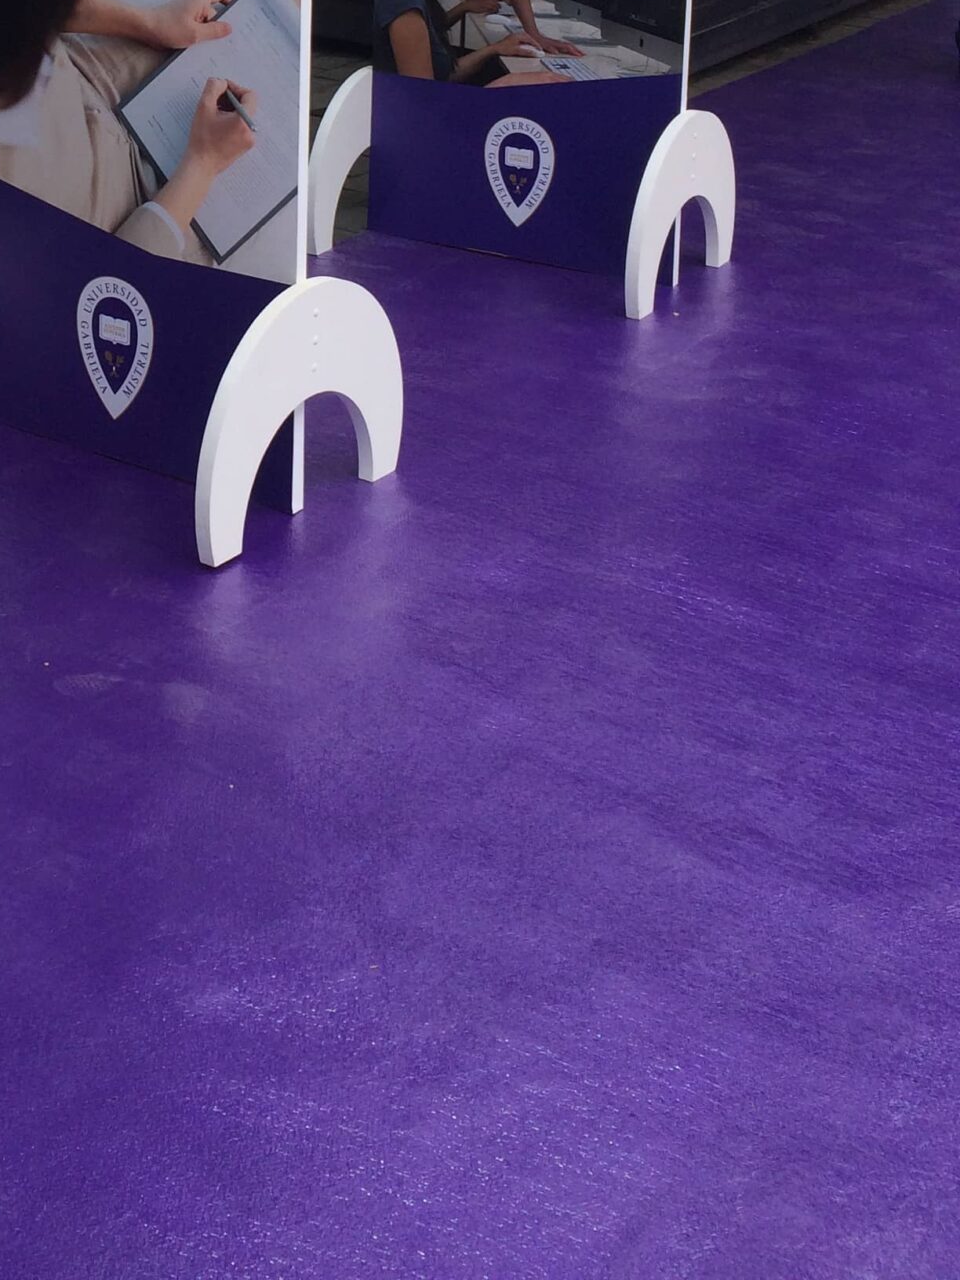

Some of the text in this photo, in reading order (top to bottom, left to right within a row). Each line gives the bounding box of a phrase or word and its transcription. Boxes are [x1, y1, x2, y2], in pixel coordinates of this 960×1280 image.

[491, 121, 549, 154] UNIVERSIDAD
[488, 152, 512, 208] GABRIELA
[525, 165, 550, 210] MISTRAL
[83, 282, 147, 327] UNIVERSIDAD
[80, 320, 108, 394] GABRIELA
[122, 342, 149, 398] MISTRAL
